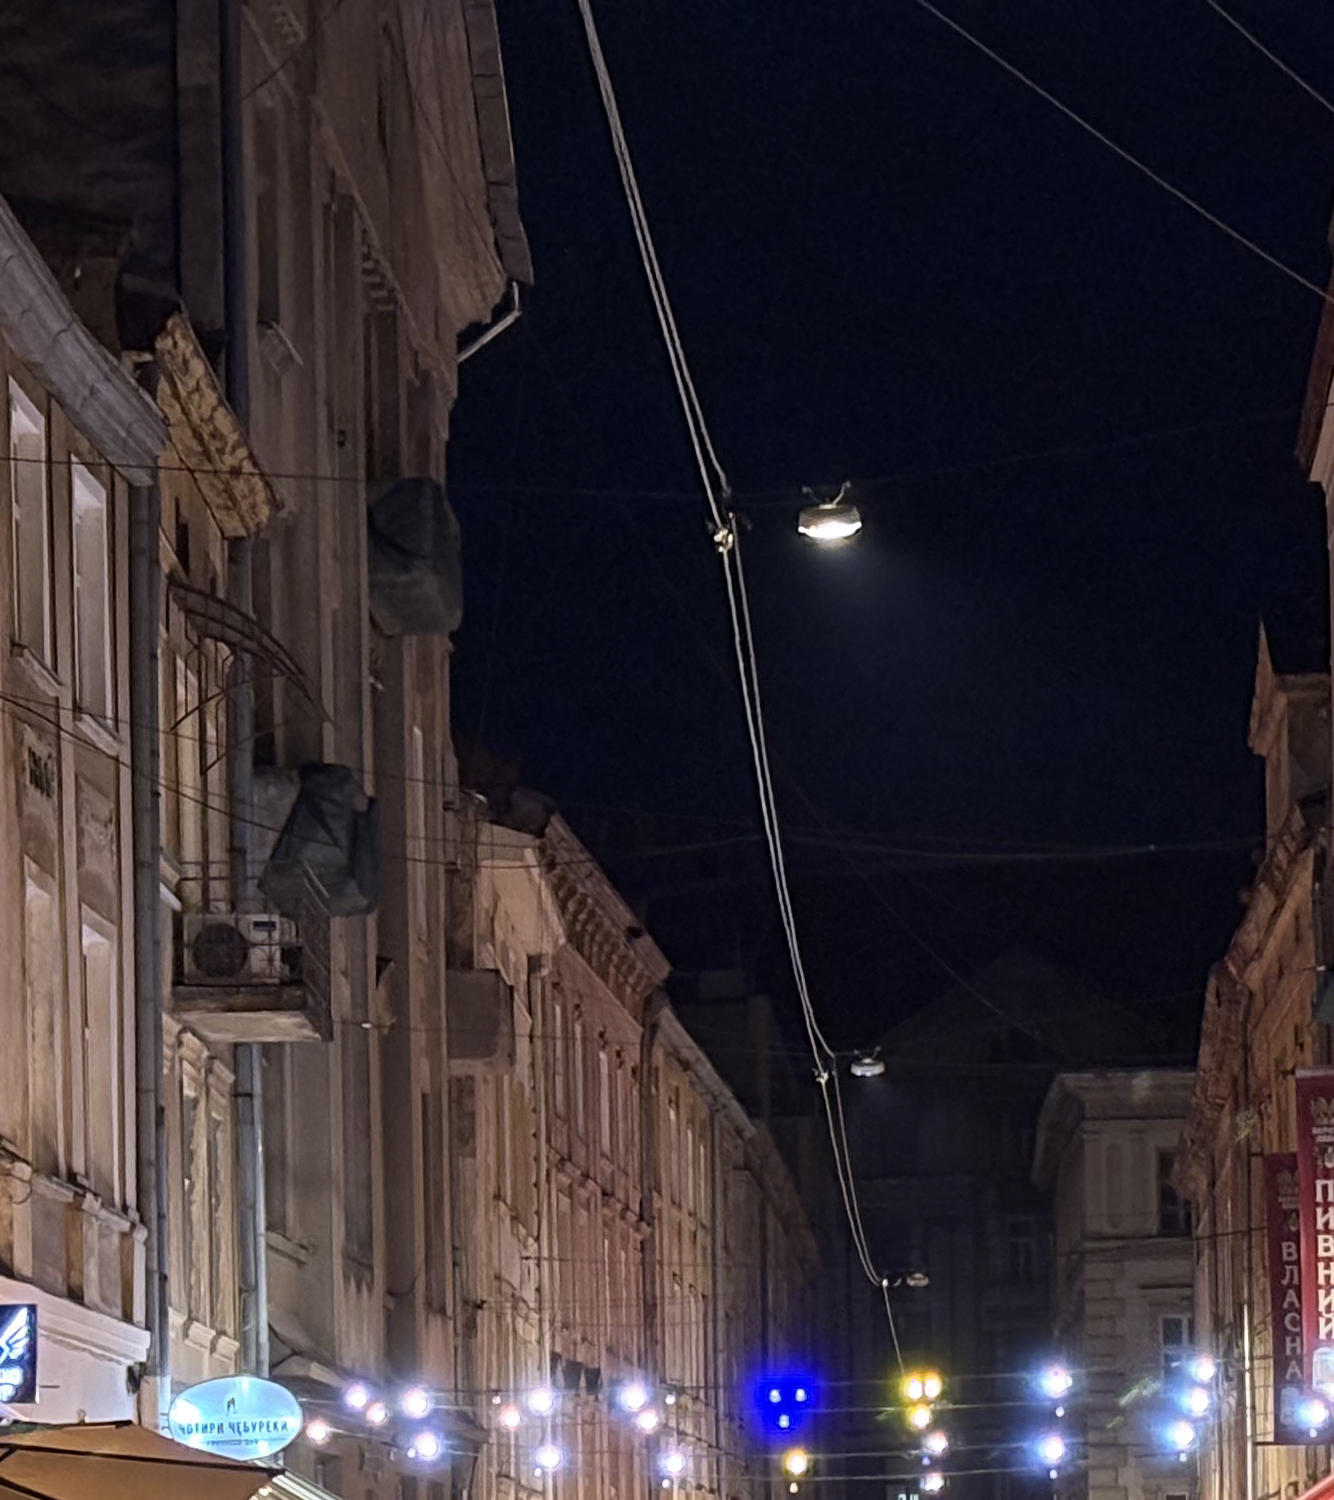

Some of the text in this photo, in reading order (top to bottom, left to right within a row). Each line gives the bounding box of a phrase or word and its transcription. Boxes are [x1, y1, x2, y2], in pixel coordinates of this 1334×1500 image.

[1280, 1241, 1303, 1379] ВЛАСНА
[178, 1420, 288, 1436] ЧОТИРИ ЧЕБУРЕКИ
